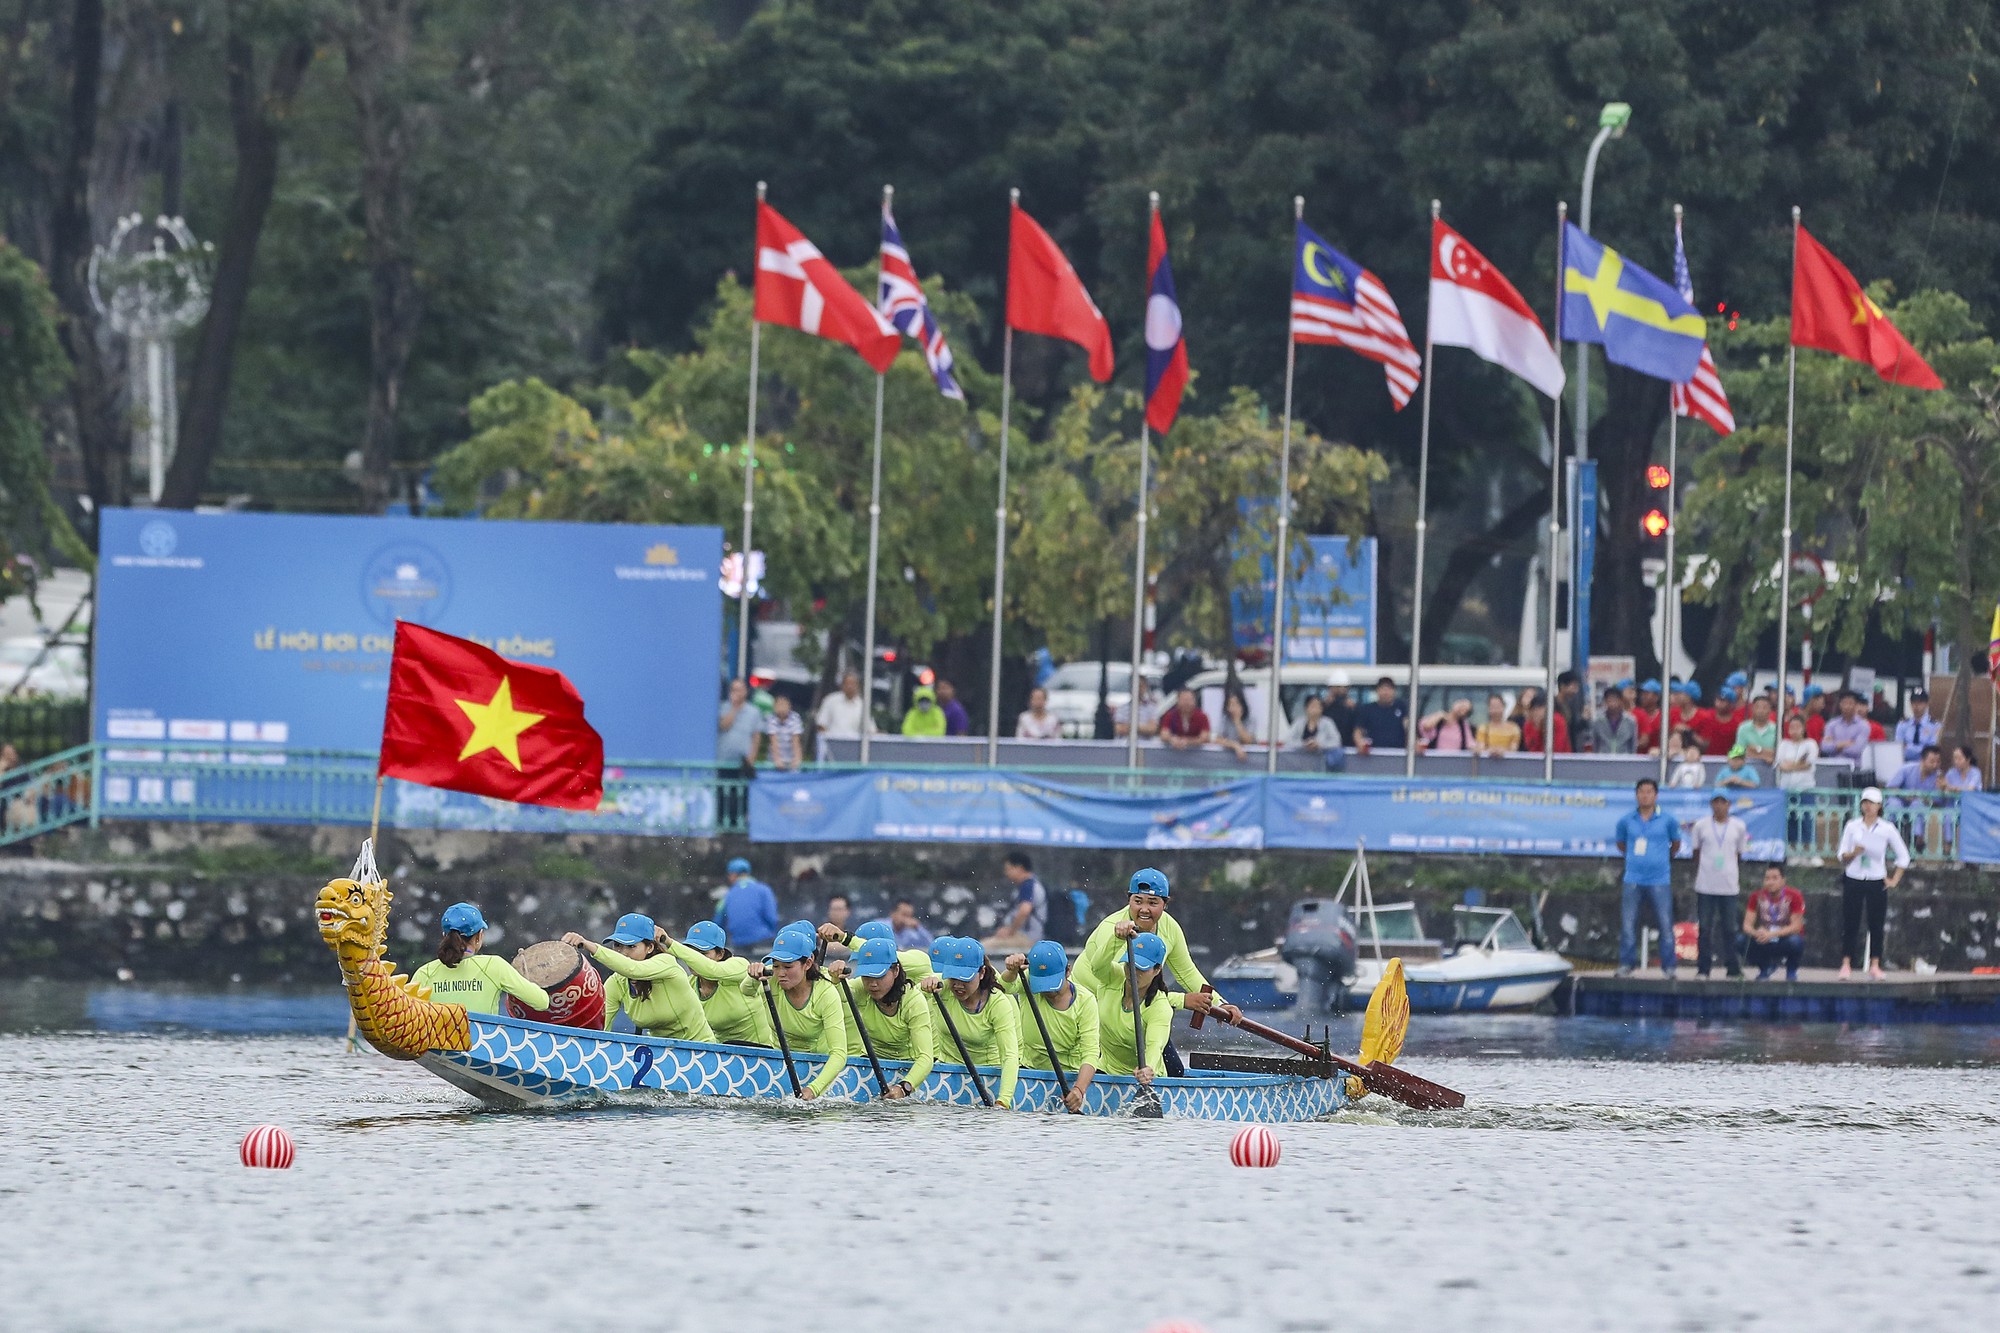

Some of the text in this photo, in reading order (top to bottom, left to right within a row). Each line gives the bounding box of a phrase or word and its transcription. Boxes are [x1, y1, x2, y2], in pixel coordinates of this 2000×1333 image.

[433, 978, 483, 994] THÁI NGUYÊN
[631, 1045, 654, 1089] 2
